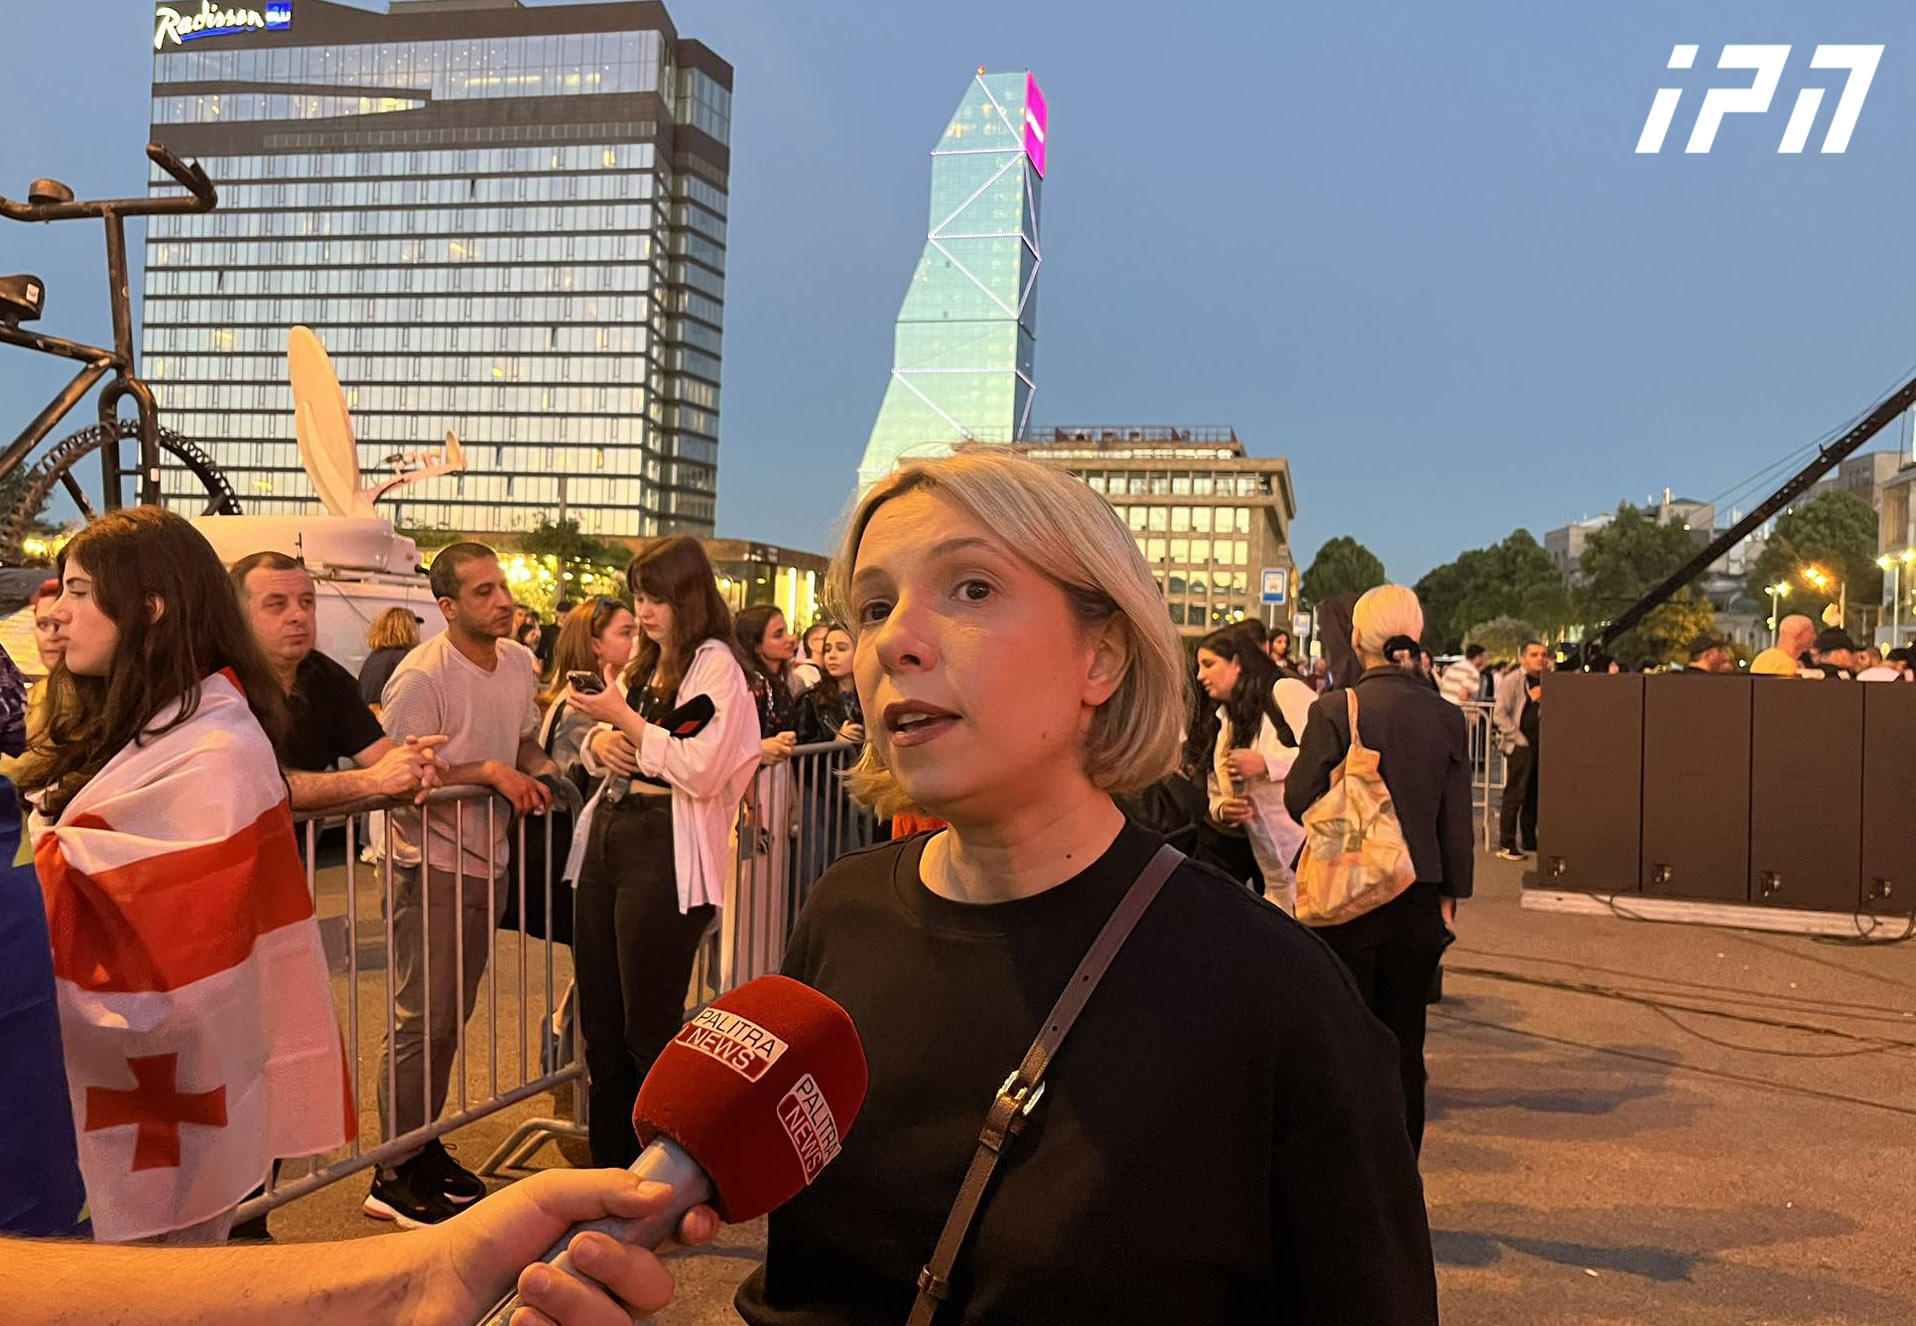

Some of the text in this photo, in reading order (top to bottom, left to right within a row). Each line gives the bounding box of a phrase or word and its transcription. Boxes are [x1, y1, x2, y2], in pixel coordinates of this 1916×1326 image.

[154, 0, 264, 49] Radisson
[686, 1027, 756, 1071] NEWS
[697, 1009, 777, 1058] PALITRA
[784, 1106, 822, 1173] NEWS
[796, 1078, 840, 1160] PALITRA
